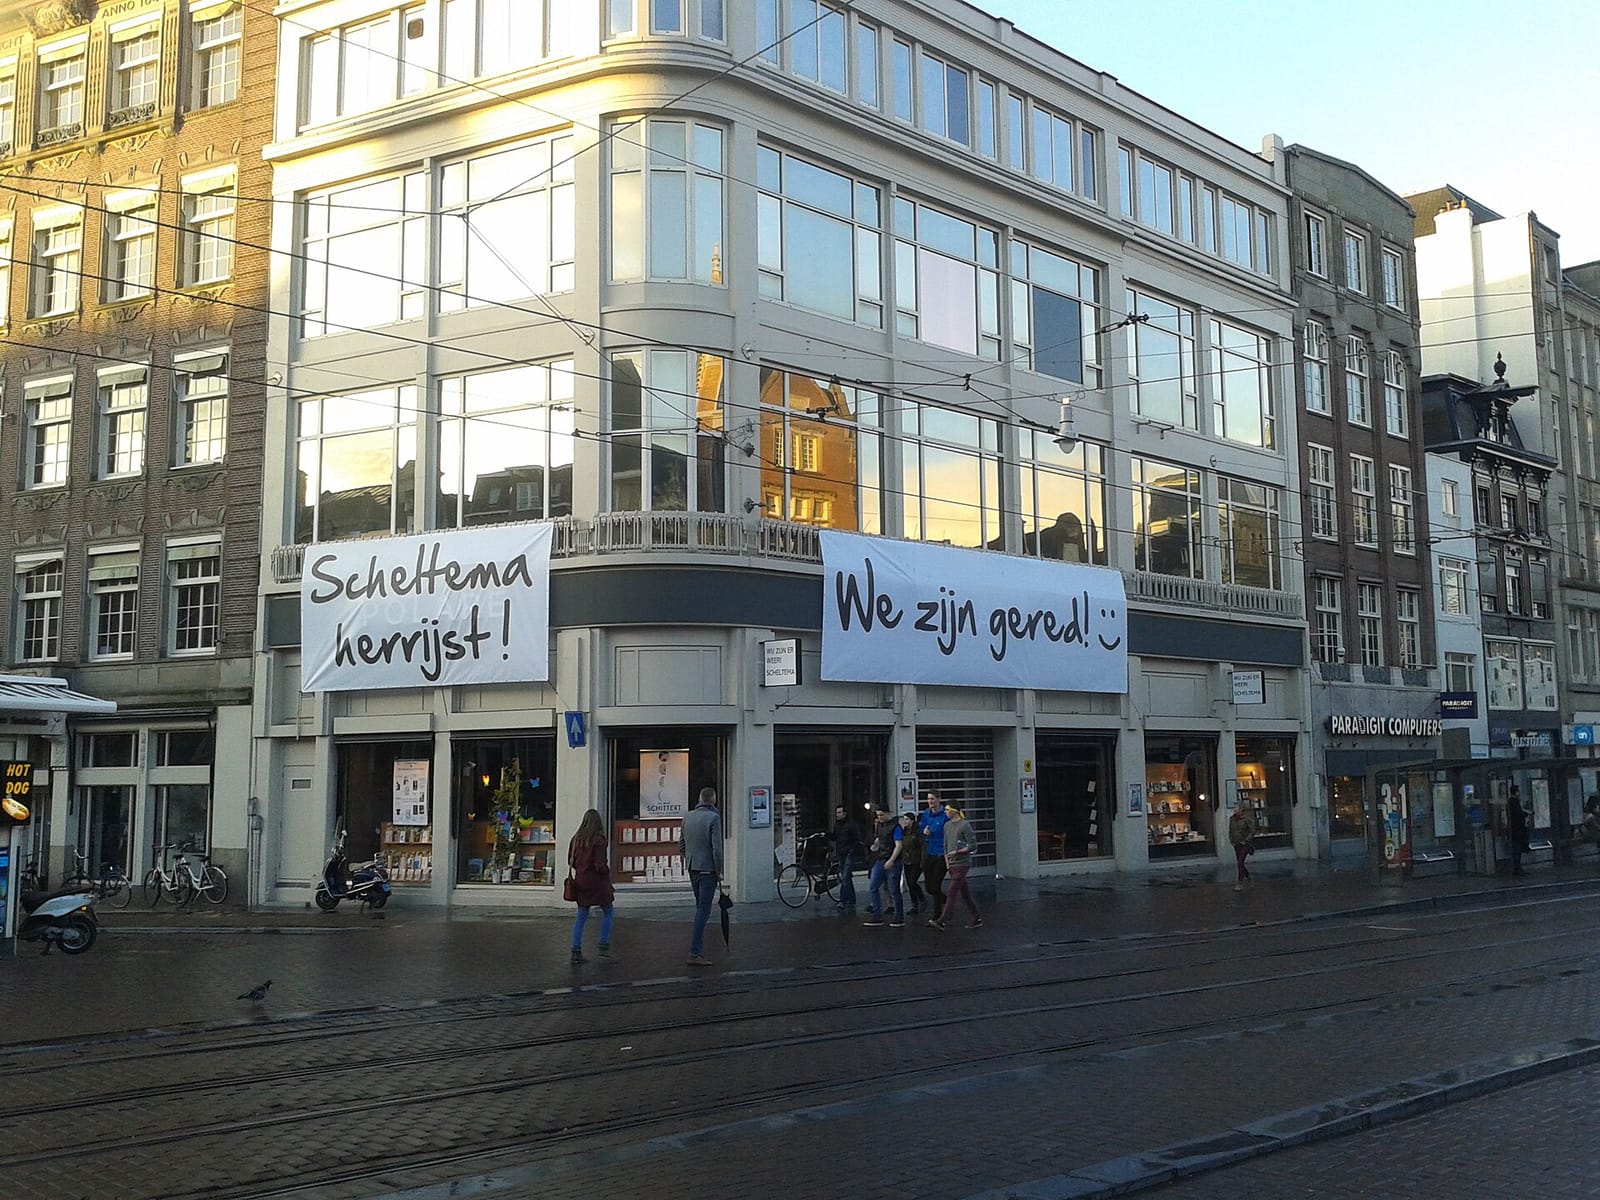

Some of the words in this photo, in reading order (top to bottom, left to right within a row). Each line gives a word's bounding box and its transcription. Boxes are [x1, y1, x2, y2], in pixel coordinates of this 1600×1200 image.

[101, 1, 135, 19] ANNO
[311, 542, 532, 604] Scheltema
[836, 557, 903, 632] We
[914, 586, 977, 655] zijn
[989, 590, 1089, 662] gered!
[335, 598, 510, 682] herrijst!
[766, 668, 795, 677] SCHELTEMA
[1331, 715, 1386, 735] PARADIGIT
[1388, 717, 1442, 737] COMPUTERS
[6, 764, 31, 777] HOT
[5, 781, 30, 795] DOG
